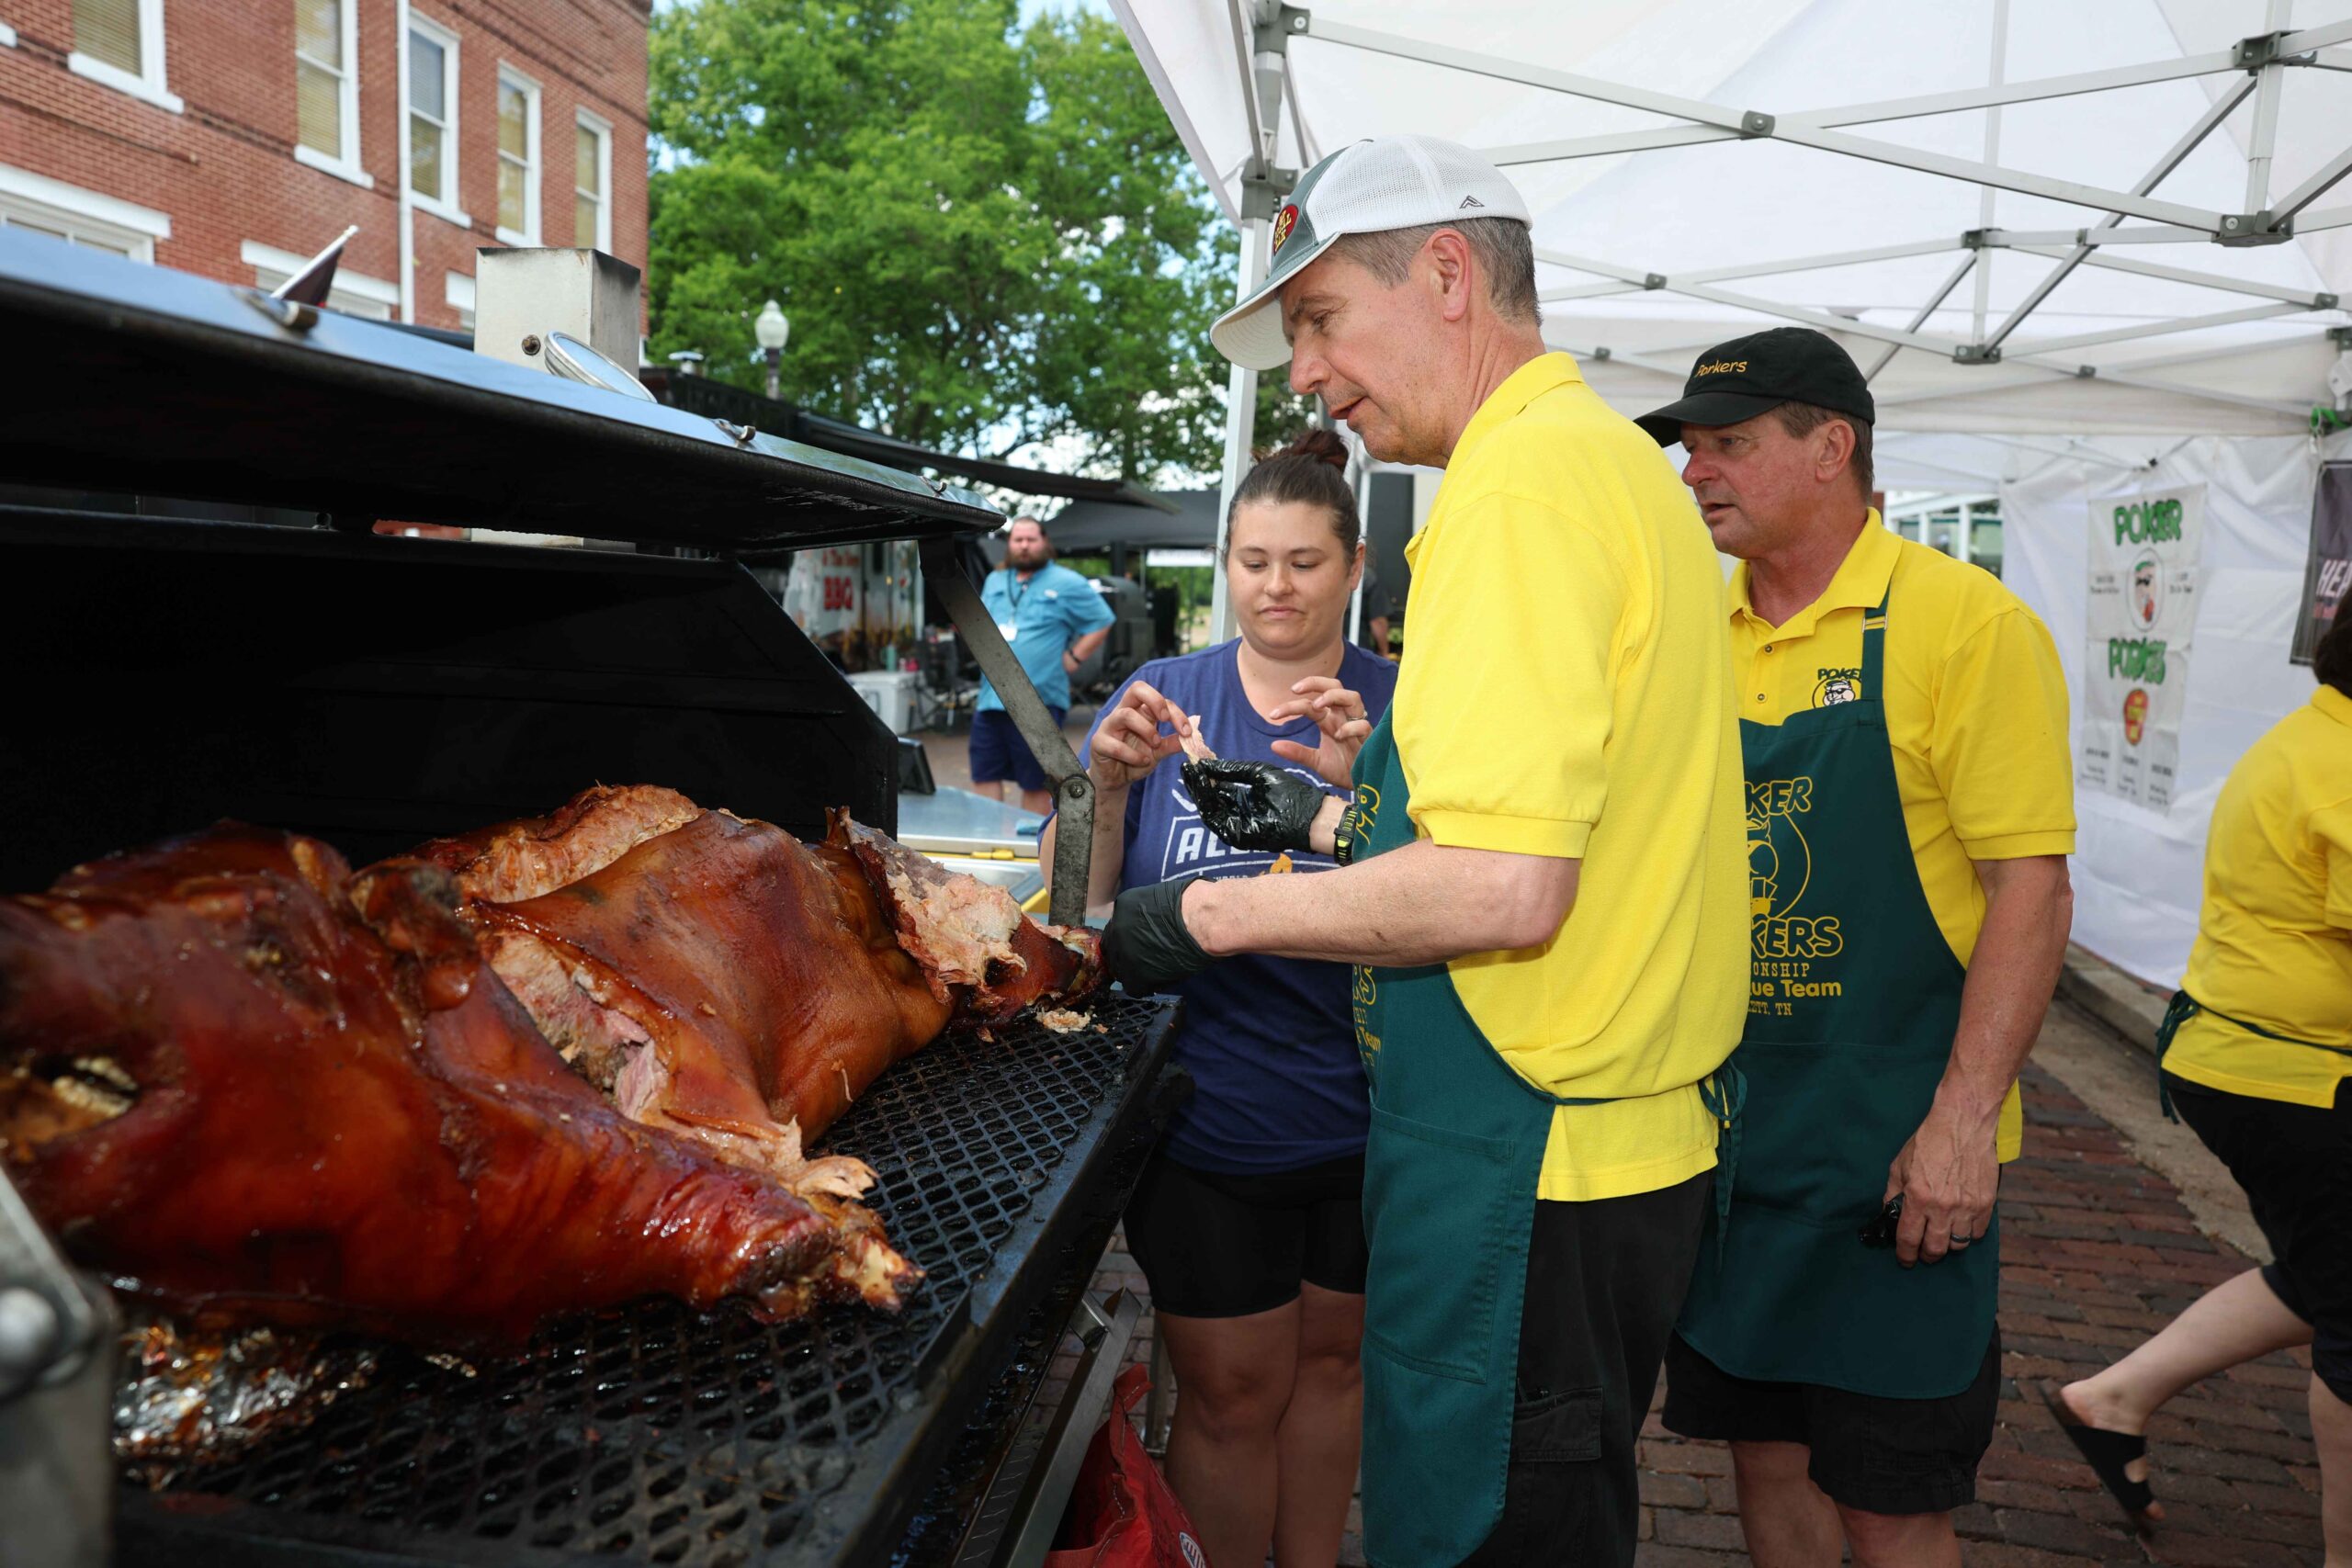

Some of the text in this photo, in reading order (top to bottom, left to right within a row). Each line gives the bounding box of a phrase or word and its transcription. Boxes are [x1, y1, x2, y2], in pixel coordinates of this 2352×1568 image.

[1694, 359, 1747, 378] Porkers
[2114, 499, 2182, 545] POKER
[824, 576, 853, 611] BBQ
[2316, 560, 2352, 597] HEA
[1817, 668, 1861, 681] POKE
[1745, 776, 1813, 818] KER
[1751, 916, 1843, 958] KERS
[1753, 961, 1810, 977] ONSHIP
[1781, 979, 1842, 998] Team
